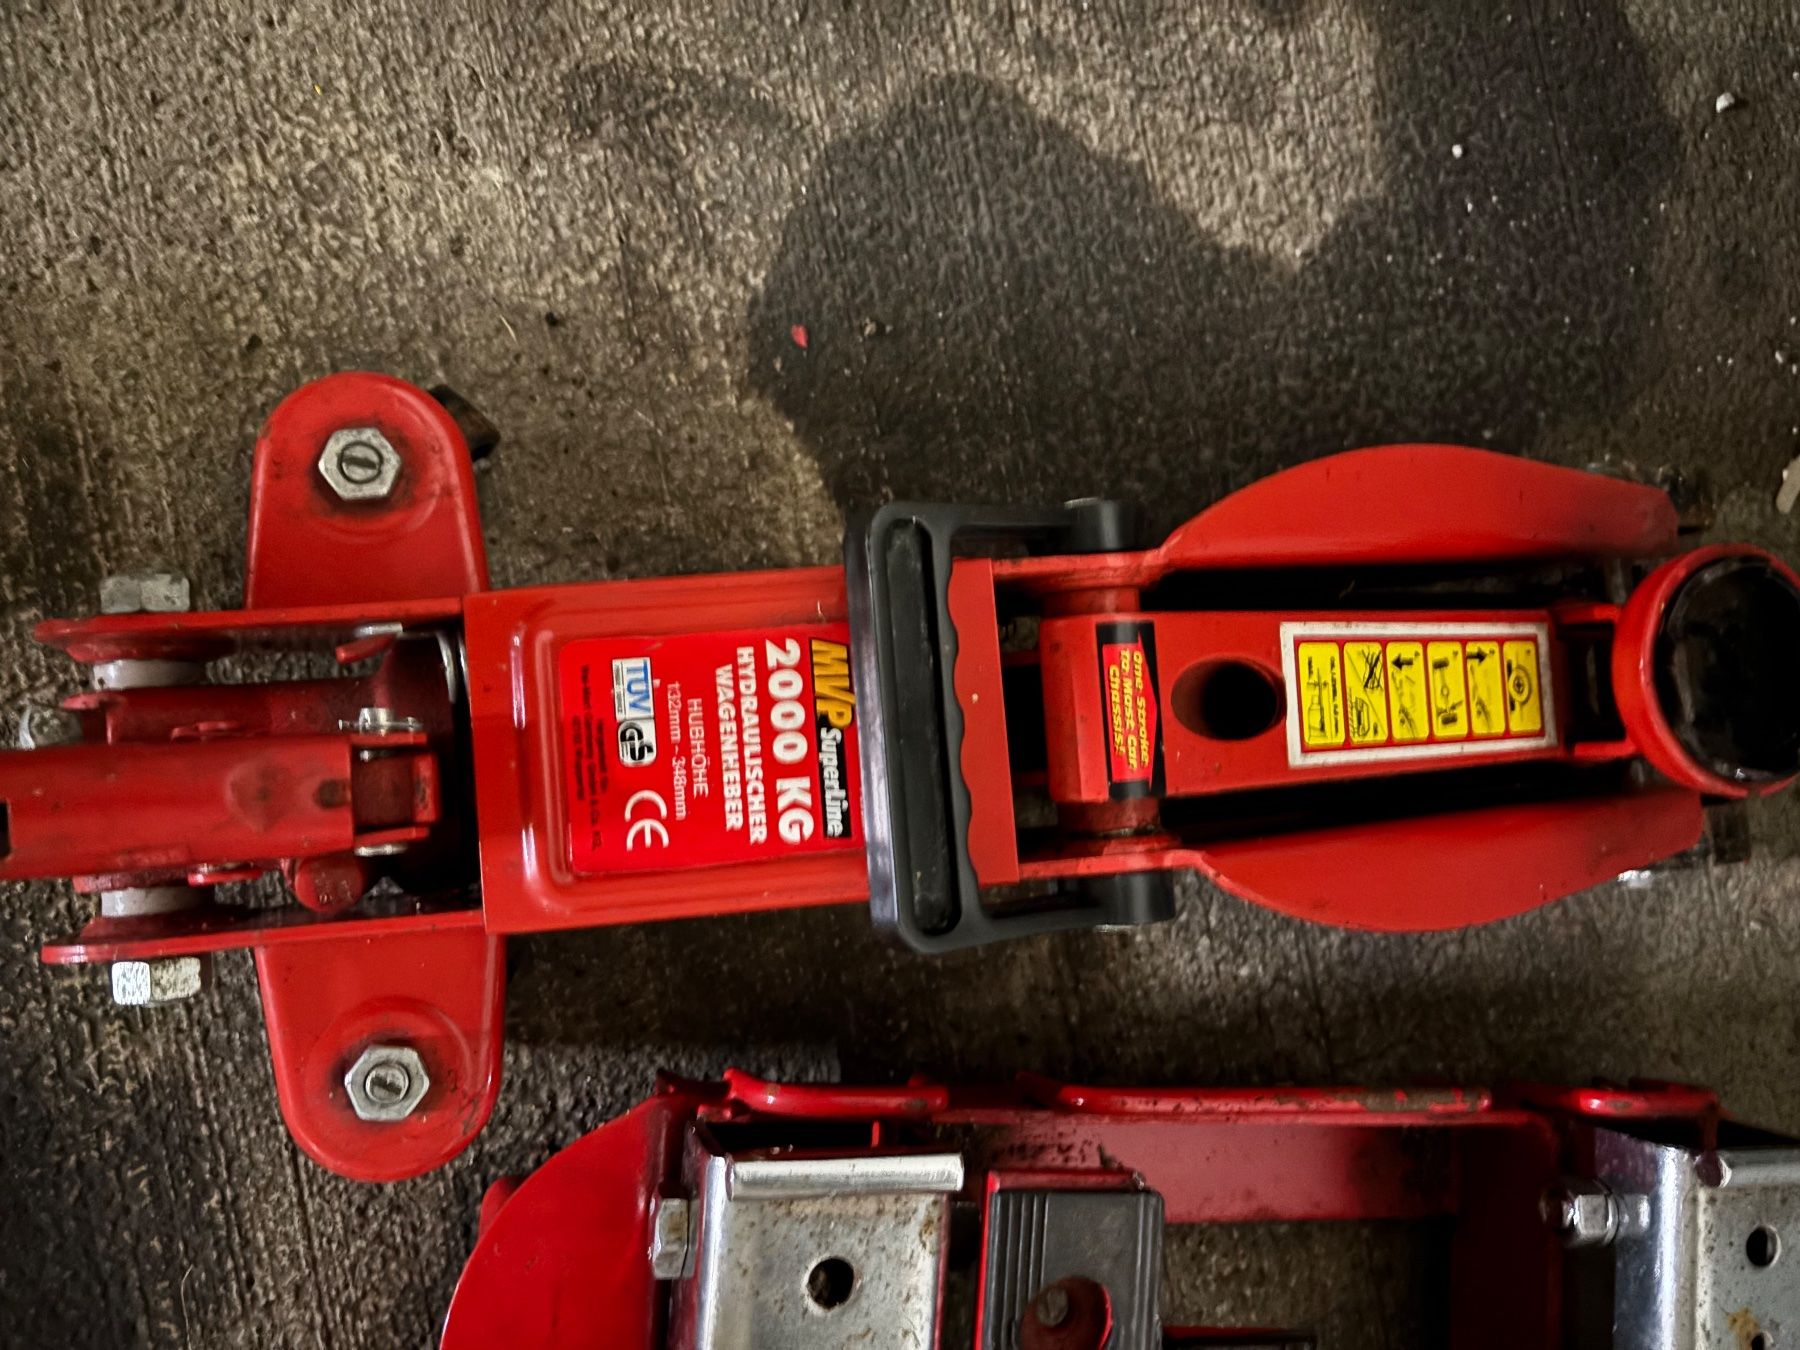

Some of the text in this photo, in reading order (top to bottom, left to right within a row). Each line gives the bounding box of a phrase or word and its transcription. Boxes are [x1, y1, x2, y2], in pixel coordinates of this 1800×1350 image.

[666, 681, 682, 745] 132mm
[687, 697, 710, 799] HUBHÖHE
[715, 664, 744, 832] WAGENHEBER
[736, 646, 768, 846] HYDRAULISCHER
[765, 638, 815, 845] 2000 KG
[811, 639, 856, 837] MVP SuperLine
[1123, 678, 1136, 731] Most
[1127, 734, 1138, 772] Car
[1133, 651, 1149, 768] One Stroke
[624, 789, 670, 852] CE
[671, 756, 687, 821] 348mm
